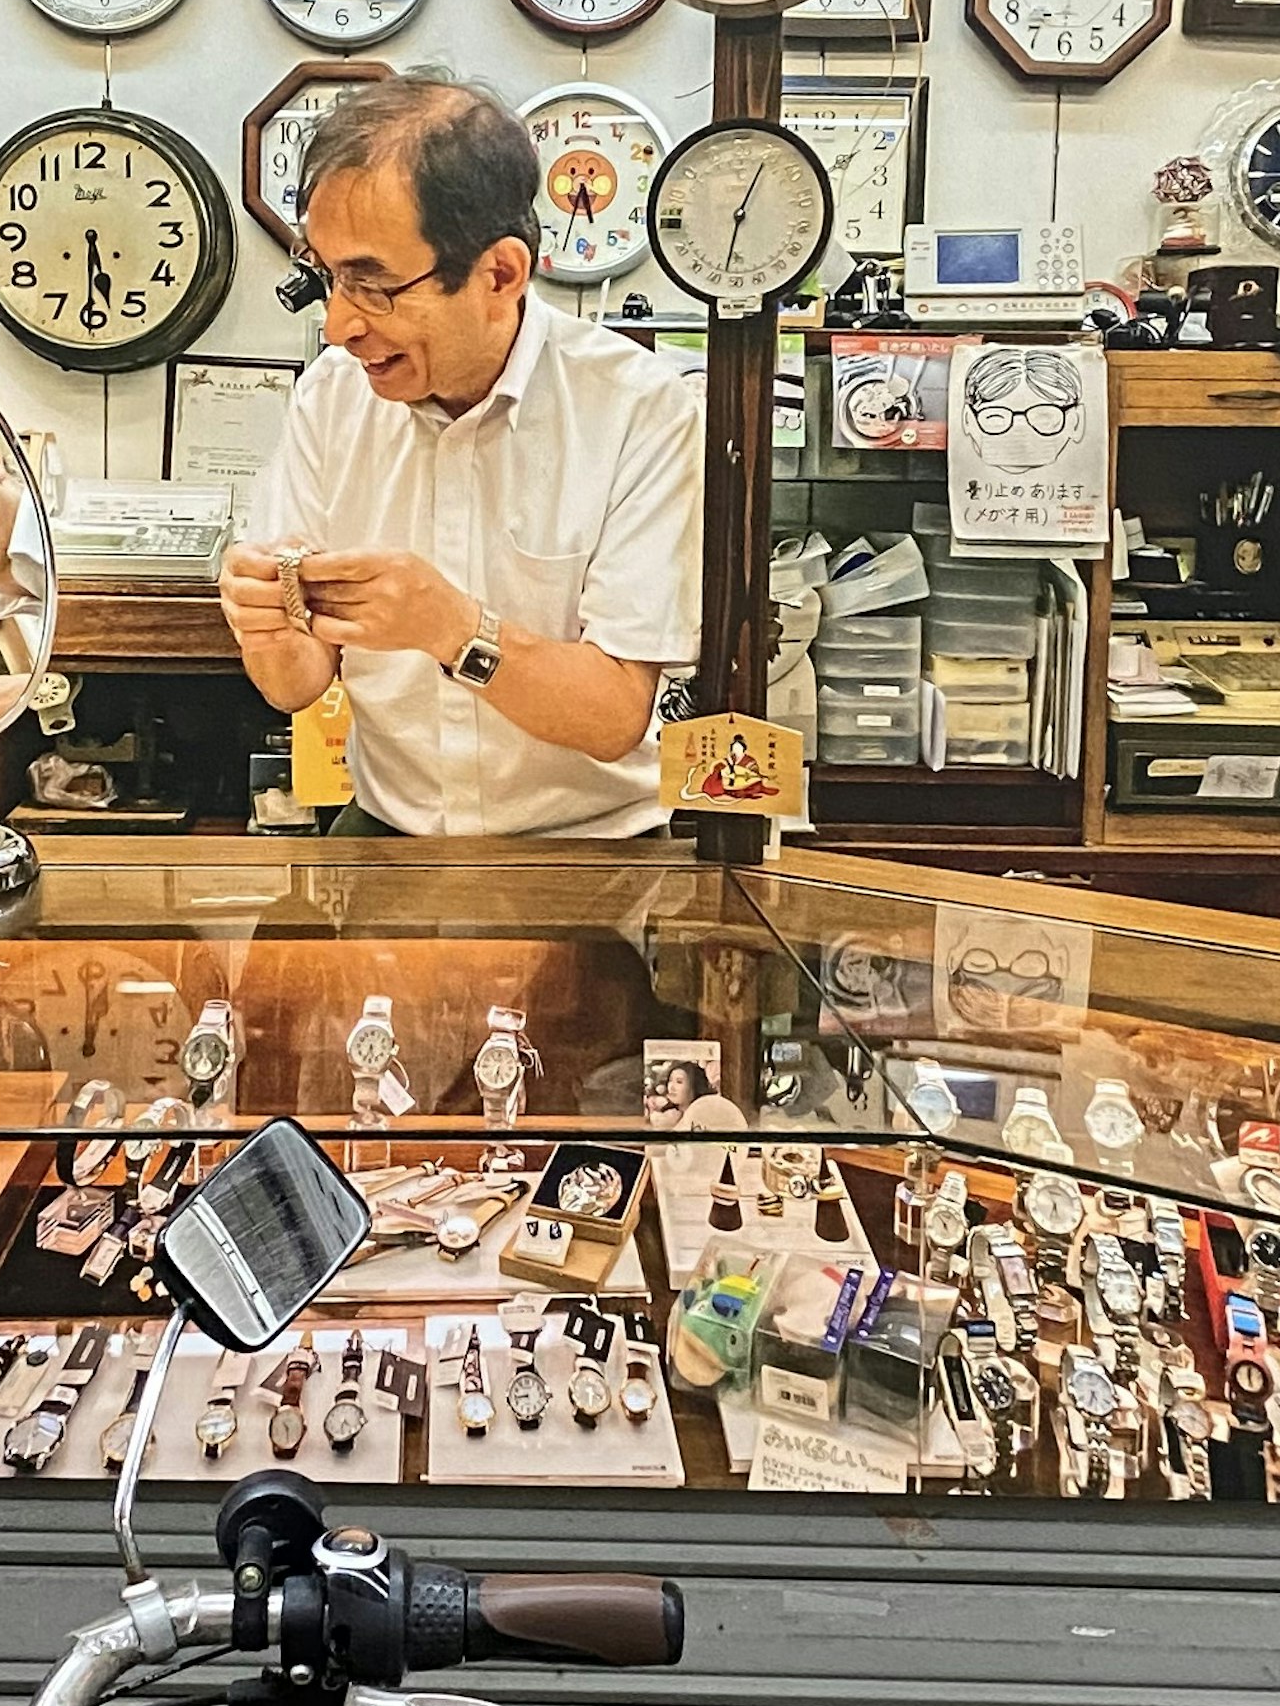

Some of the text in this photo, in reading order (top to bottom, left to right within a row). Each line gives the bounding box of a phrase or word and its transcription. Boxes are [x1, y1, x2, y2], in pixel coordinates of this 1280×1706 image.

[1005, 0, 1019, 24] 8
[1113, 3, 1125, 27] 4
[1058, 31, 1072, 55] 6
[1090, 27, 1103, 51] 5
[41, 154, 59, 181] 11
[75, 142, 106, 168] 12
[126, 152, 131, 178] 1
[10, 184, 37, 211] 10
[145, 180, 170, 207] 2
[0, 223, 26, 253] 9
[159, 222, 183, 248] 3
[12, 261, 37, 288] 8
[150, 259, 175, 286] 4
[43, 293, 68, 320] 7
[79, 296, 107, 329] 6
[121, 291, 146, 317] 5
